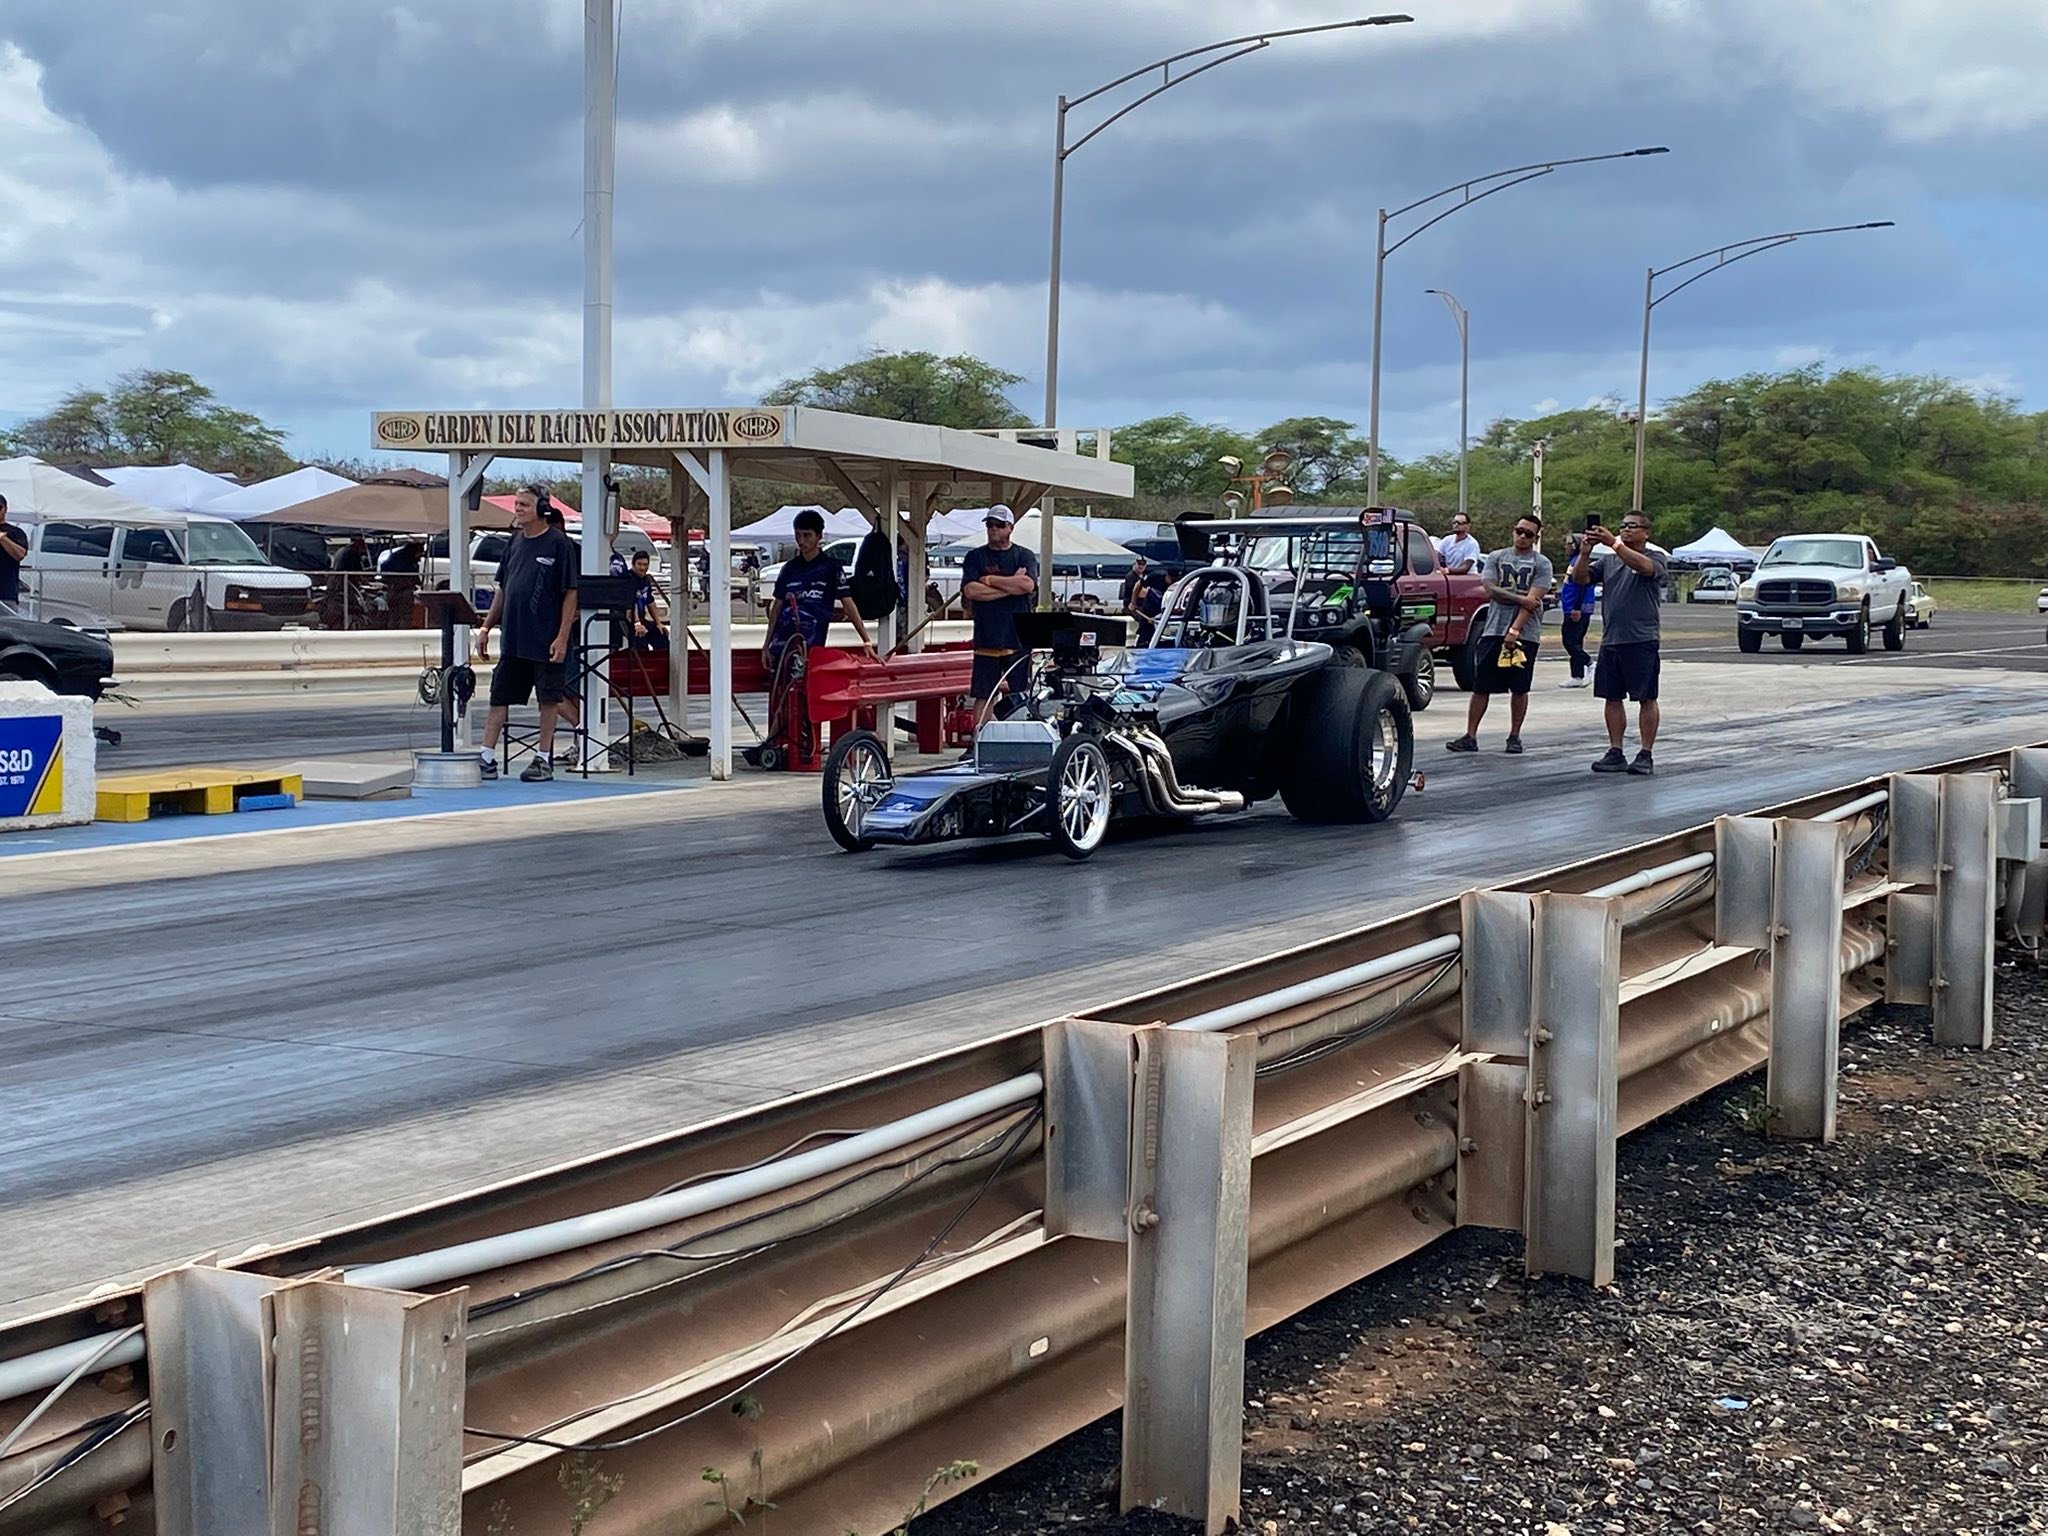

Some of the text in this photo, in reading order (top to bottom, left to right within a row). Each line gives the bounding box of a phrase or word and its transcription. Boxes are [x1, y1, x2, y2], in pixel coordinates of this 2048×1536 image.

[383, 421, 416, 439] NHRA
[425, 412, 730, 444] GARDEN ISLE RACING ASSOCIATION
[739, 416, 775, 437] NHRA
[1500, 562, 1532, 593] M
[0, 749, 33, 773] S&D
